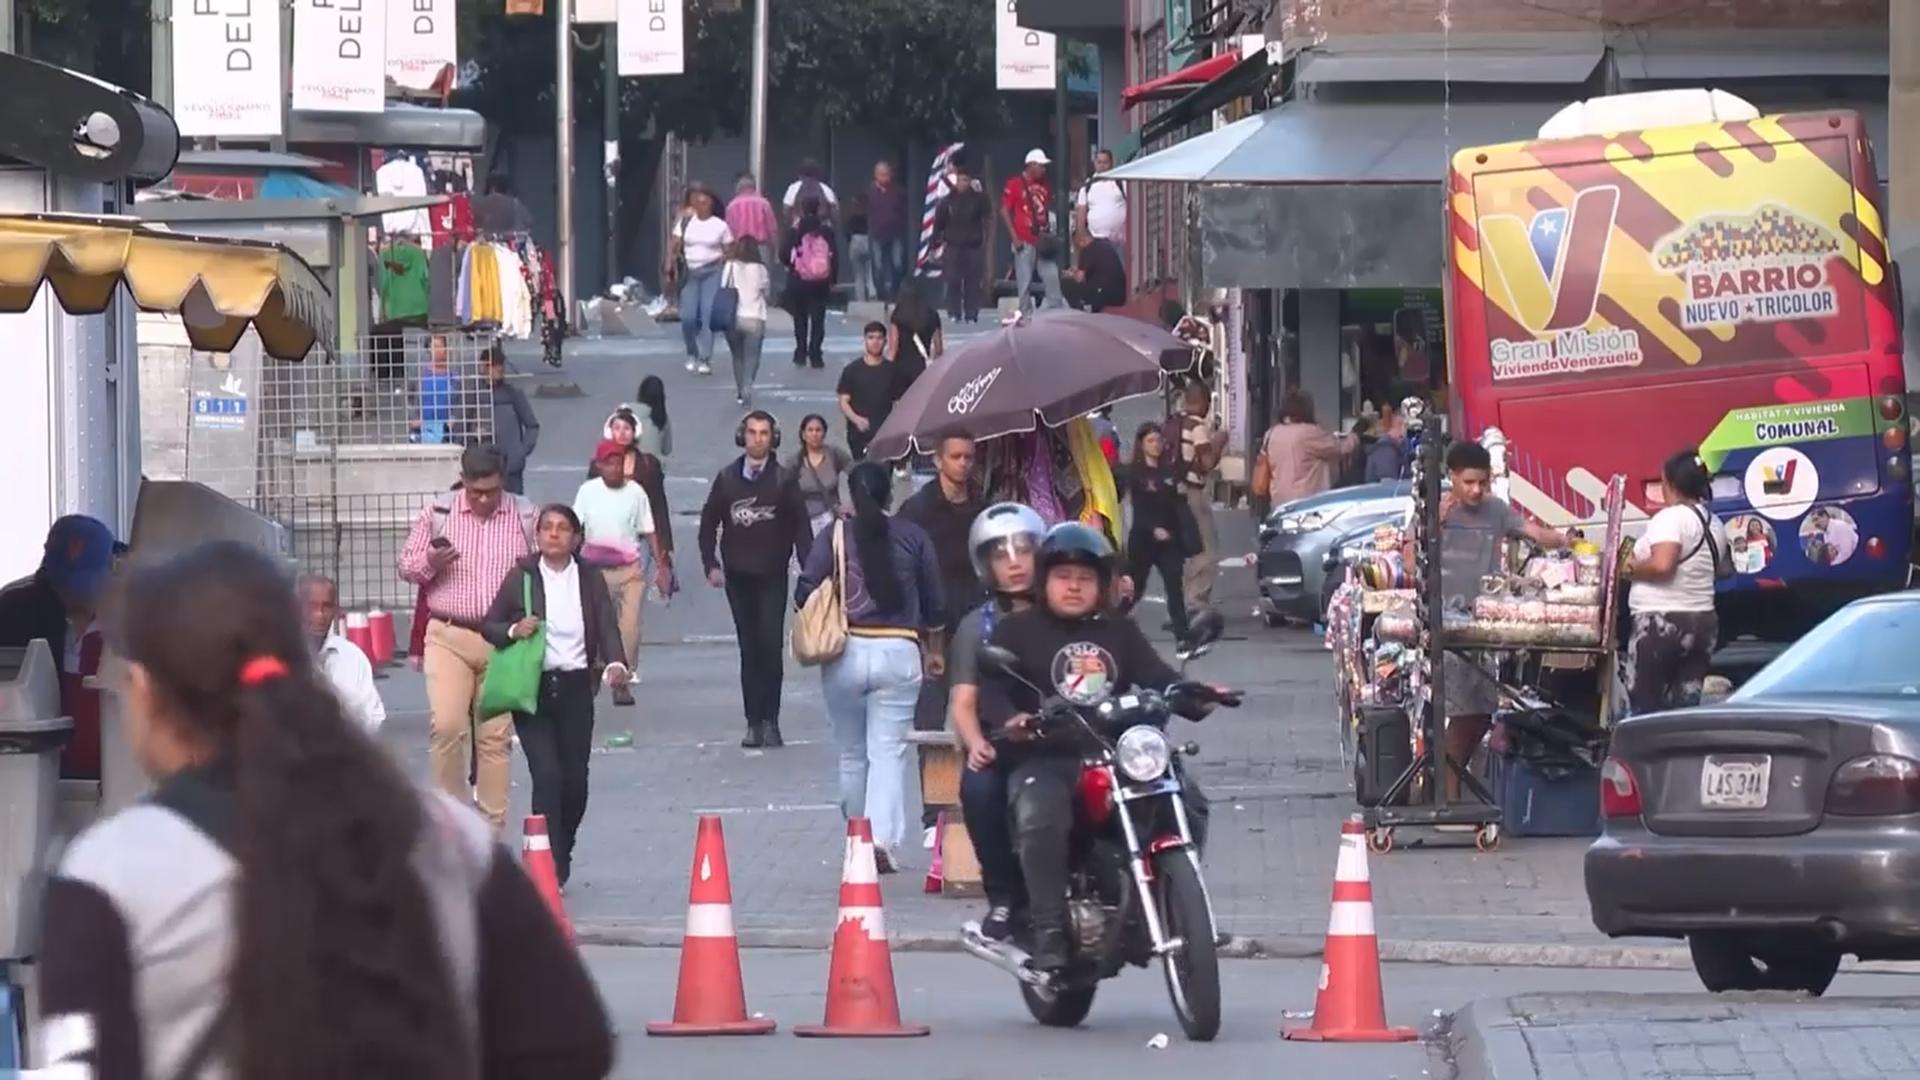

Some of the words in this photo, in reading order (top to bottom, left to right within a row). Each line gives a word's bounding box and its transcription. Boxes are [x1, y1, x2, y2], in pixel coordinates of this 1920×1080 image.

[225, 0, 251, 71] DEL
[1691, 264, 1822, 300] BARRIO
[1686, 300, 1739, 324] NUEVO
[1756, 291, 1833, 317] TRICOLOR
[1492, 340, 1550, 362] Gran
[1558, 327, 1637, 356] Misión
[1735, 409, 1780, 421] HABITAT
[1785, 408, 1791, 416] Y
[1793, 403, 1845, 415] VIVIENDA
[1756, 419, 1837, 440] COMUNAL
